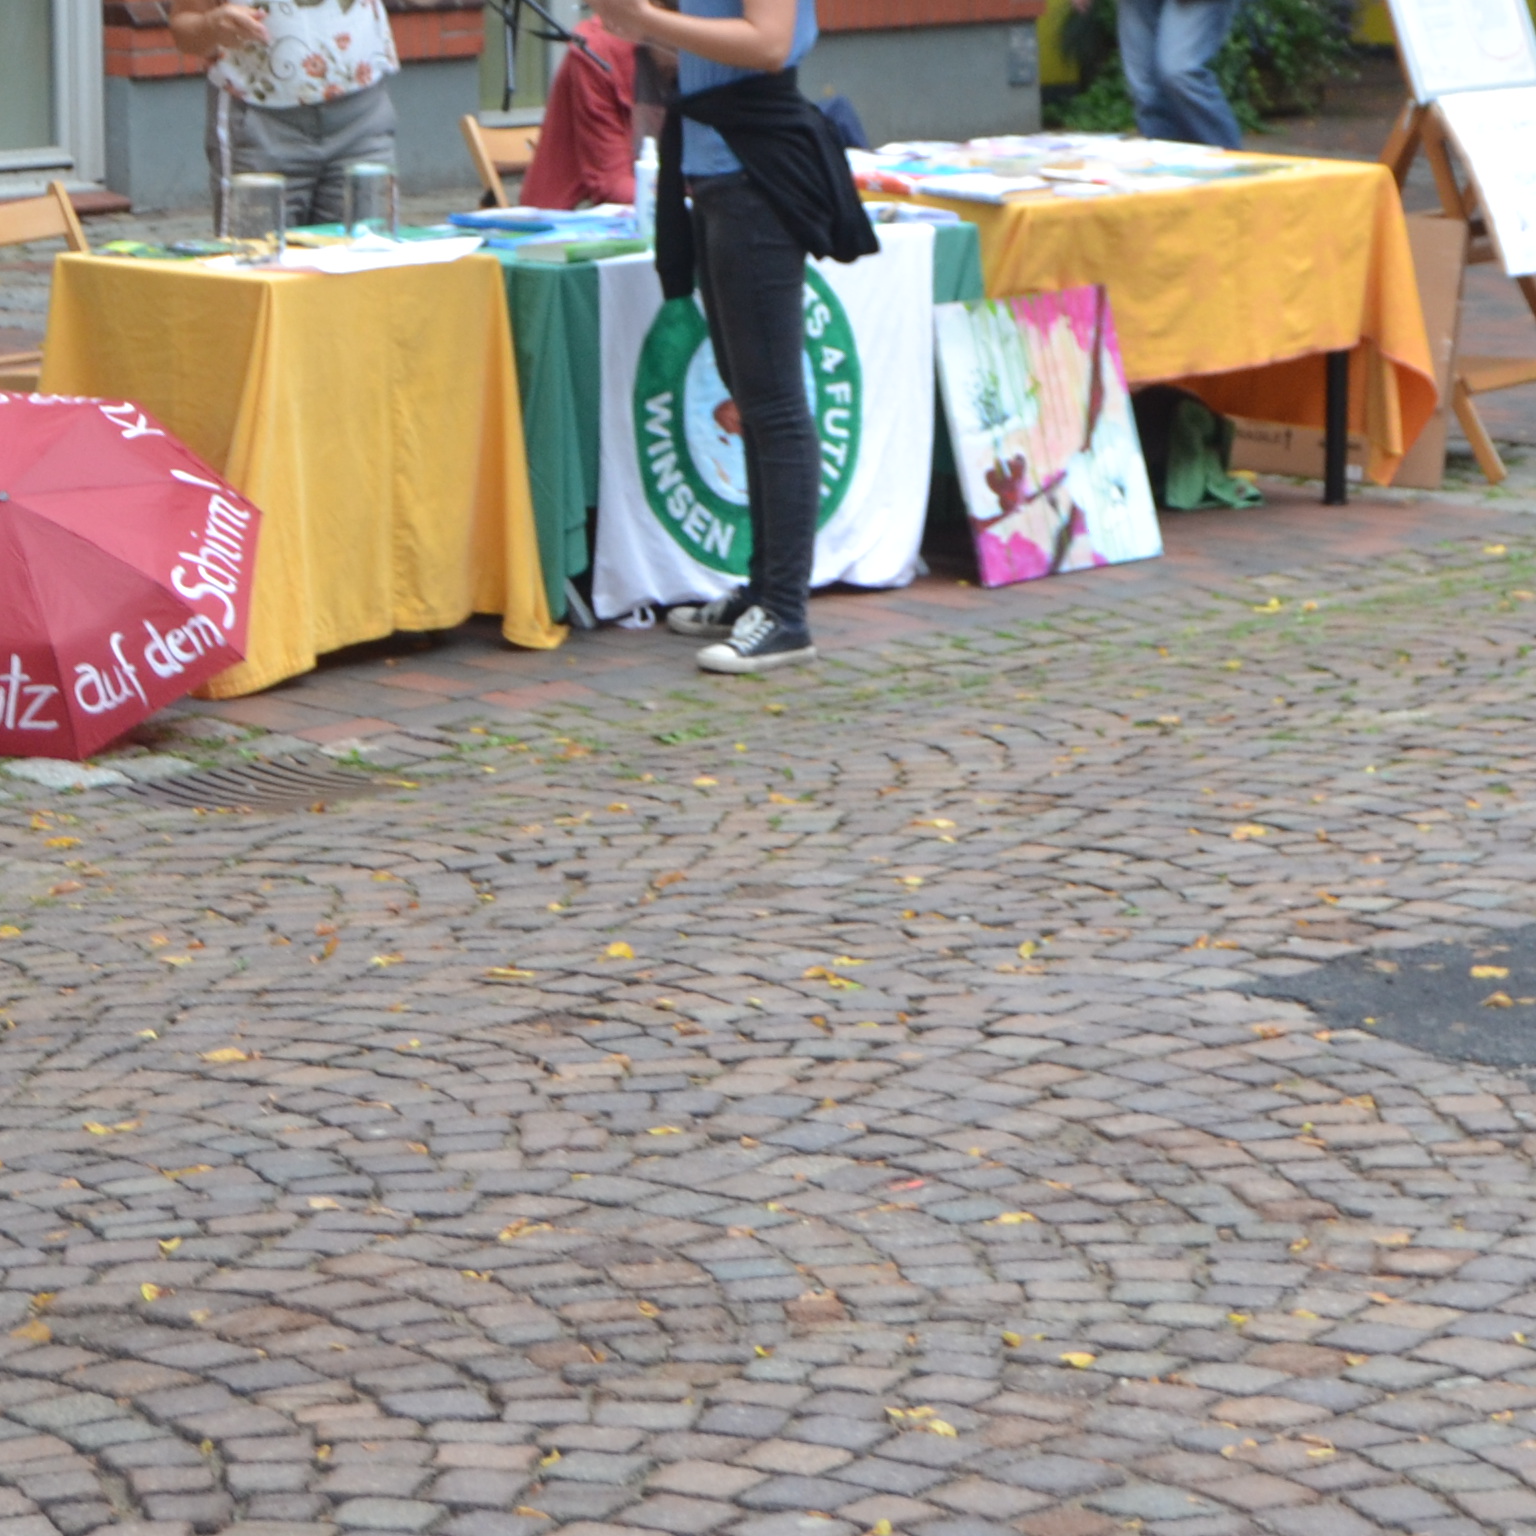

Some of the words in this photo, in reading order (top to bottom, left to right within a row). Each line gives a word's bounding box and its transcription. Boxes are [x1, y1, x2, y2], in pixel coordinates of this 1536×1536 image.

[645, 392, 735, 560] WINSEN
[170, 468, 251, 630] Schirm!
[74, 631, 150, 714] auf
[143, 614, 227, 679] dem
